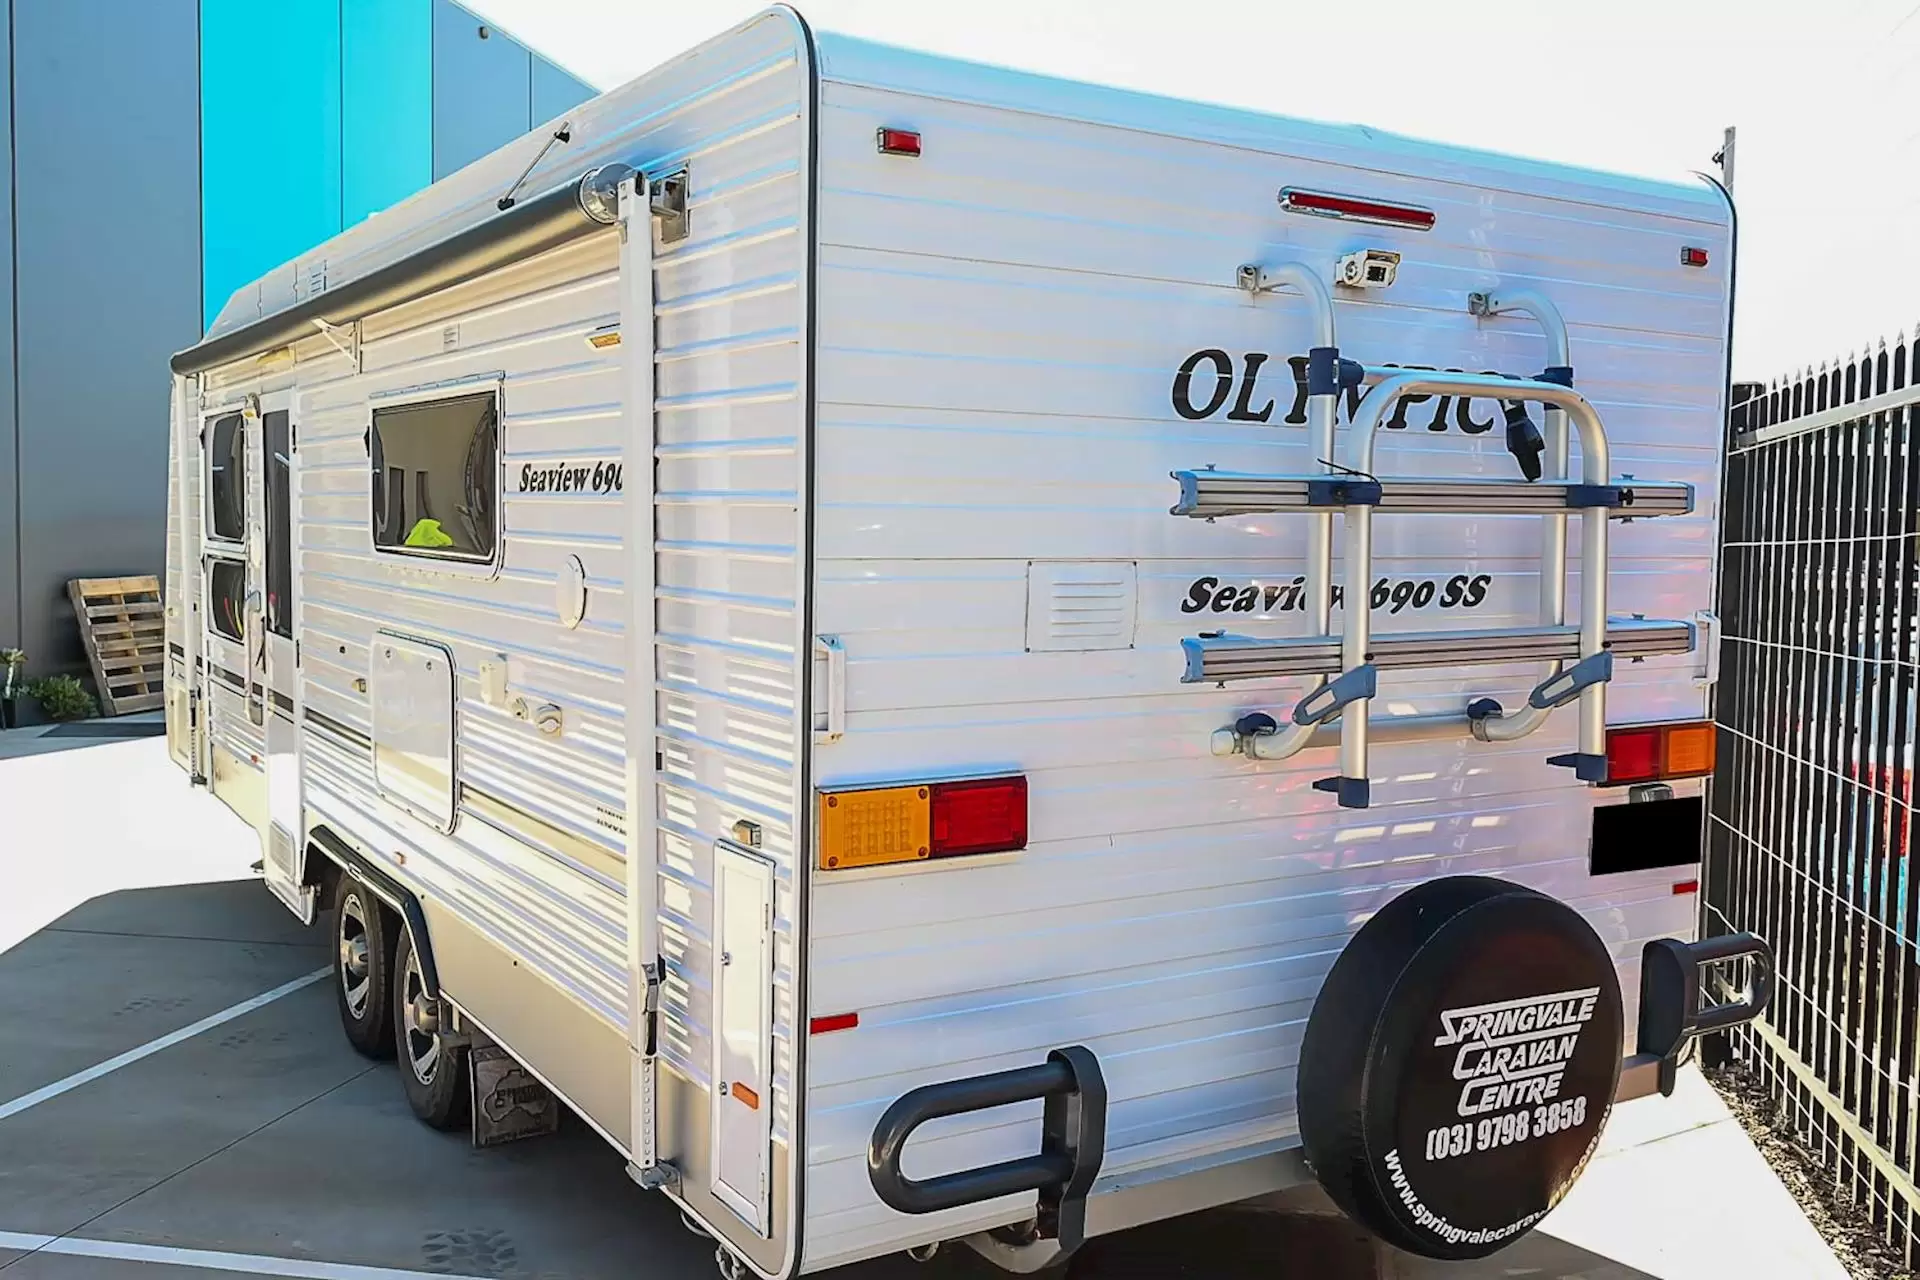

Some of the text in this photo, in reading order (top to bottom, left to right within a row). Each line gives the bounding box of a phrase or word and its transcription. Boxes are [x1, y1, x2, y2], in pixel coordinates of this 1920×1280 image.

[519, 462, 591, 492] Seaview
[1181, 575, 1492, 614] Seavi 690 SS
[1434, 987, 1600, 1047] SPRINGVALE
[1453, 1035, 1578, 1081] CARAVAN
[1457, 1072, 1564, 1117] CENTRE
[1426, 1095, 1587, 1161] (03) 9798 3858
[1384, 1103, 1612, 1245] www.springvalecaravs.com.au
